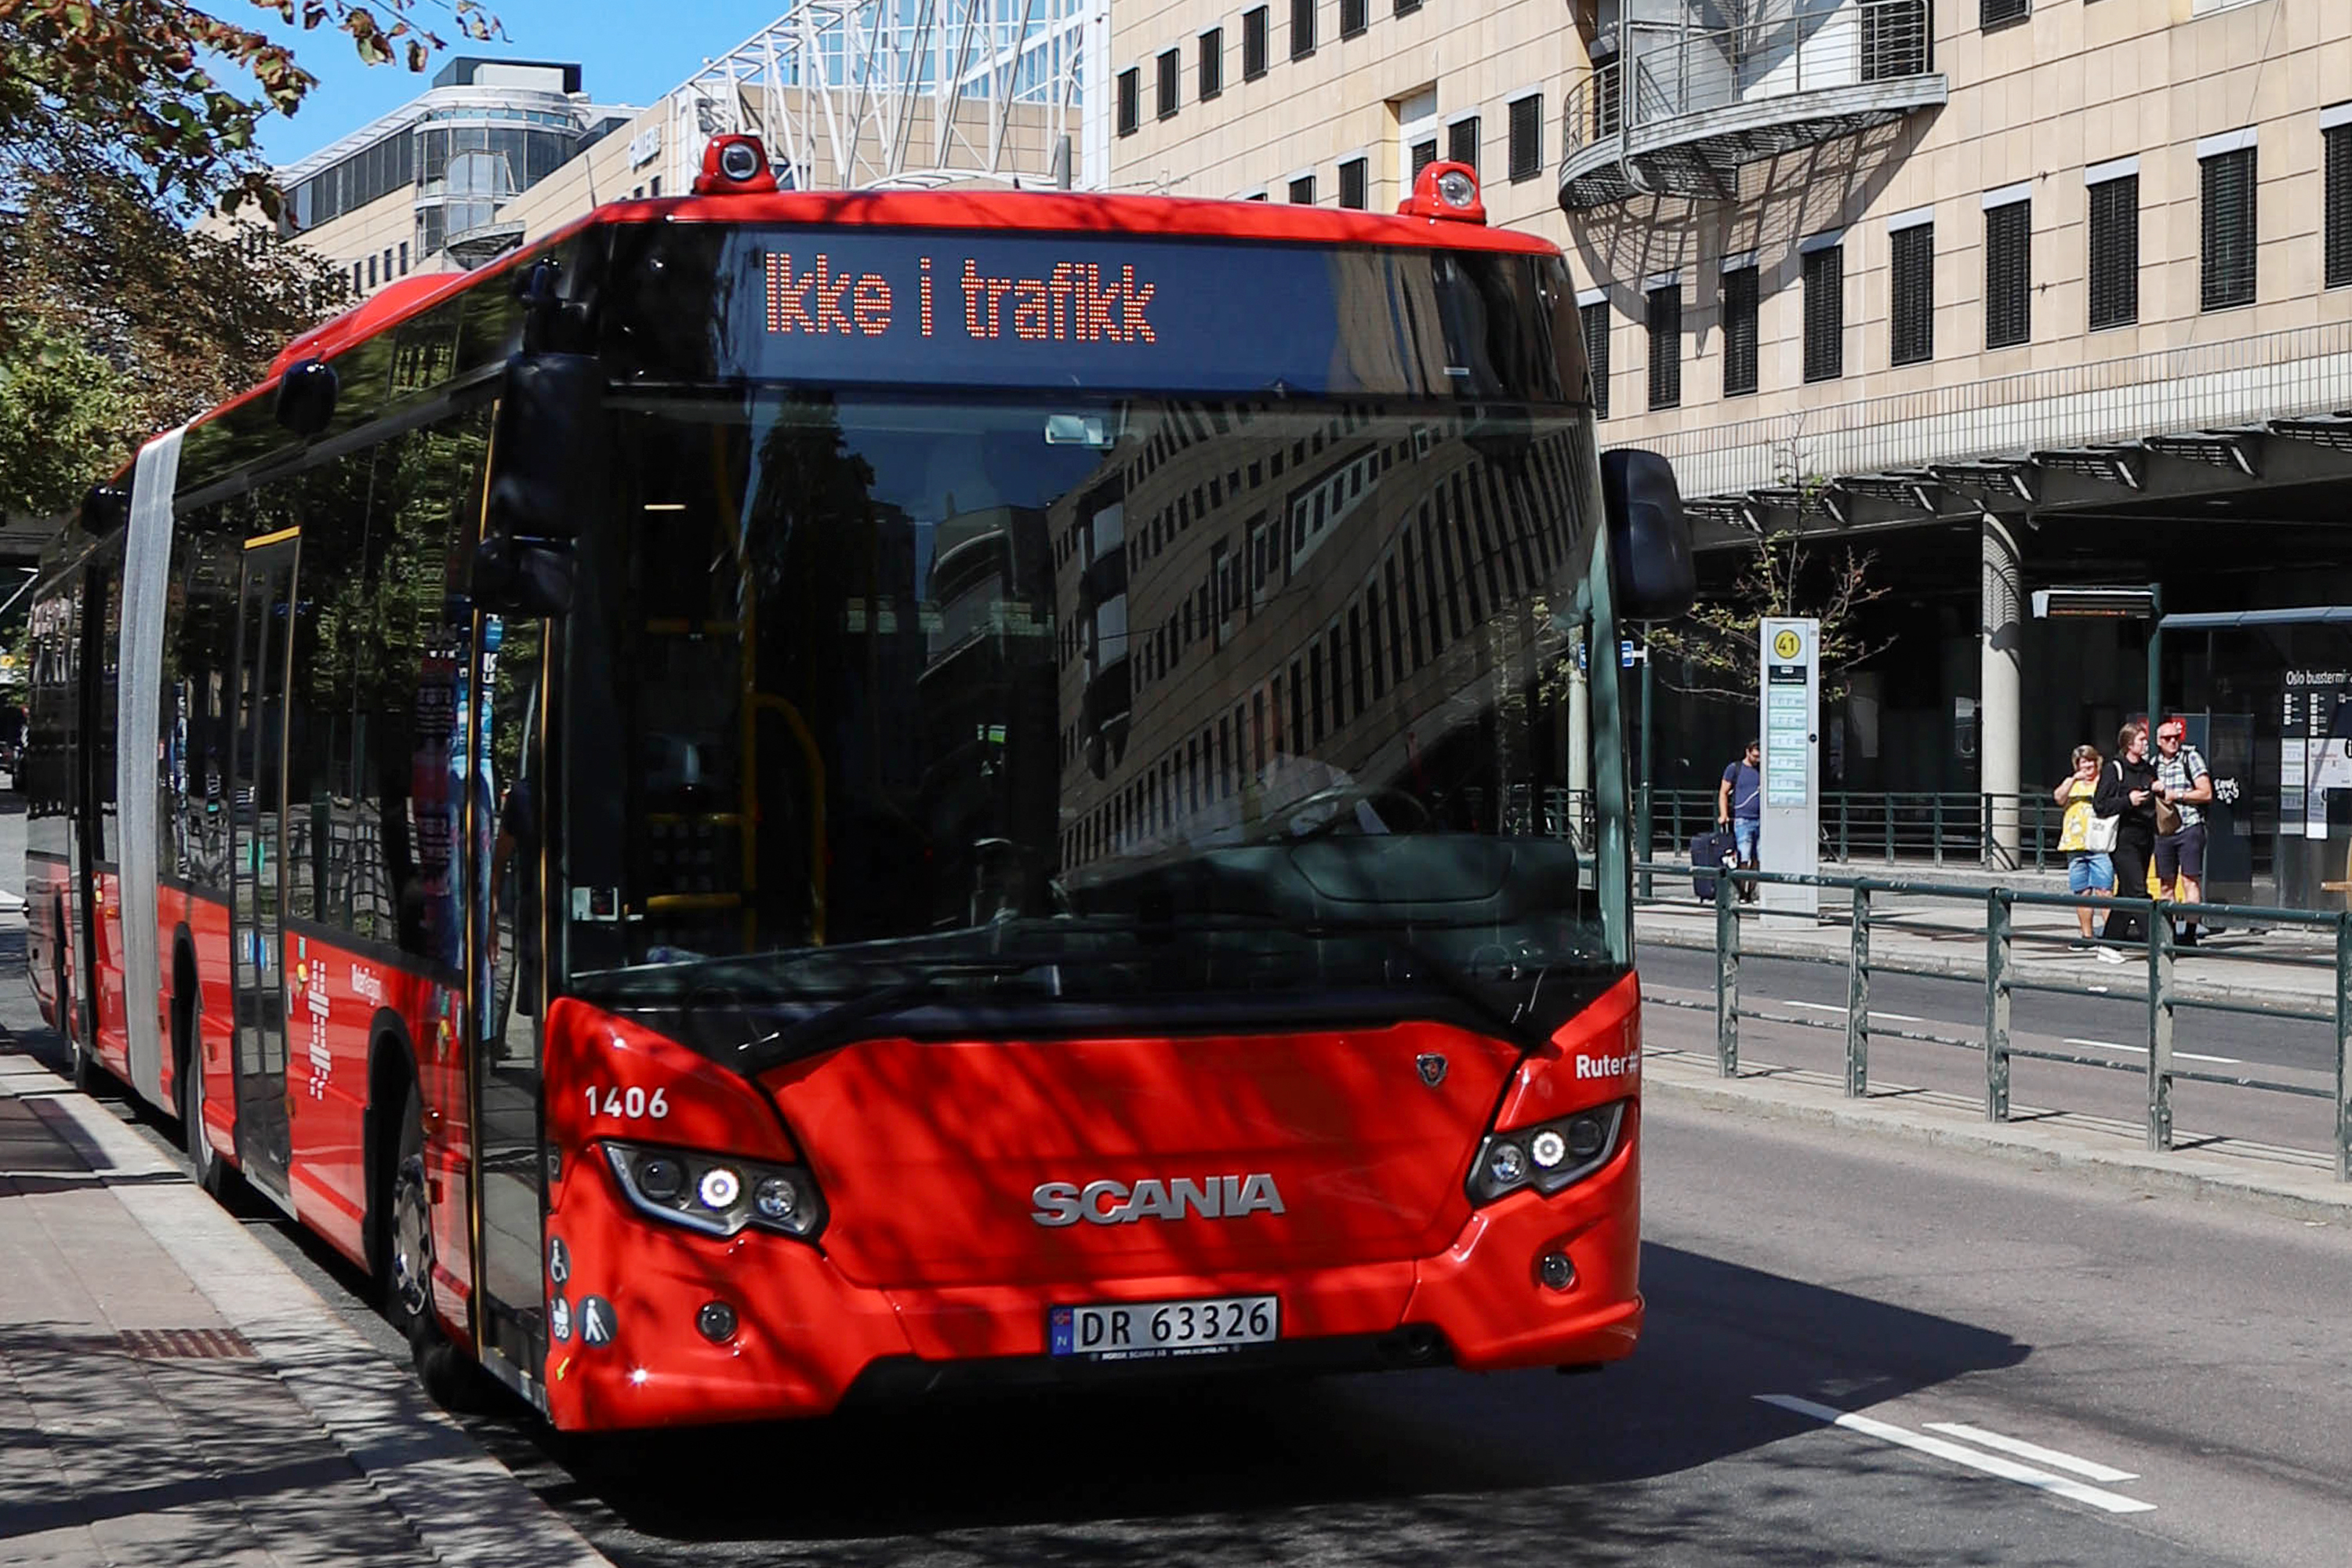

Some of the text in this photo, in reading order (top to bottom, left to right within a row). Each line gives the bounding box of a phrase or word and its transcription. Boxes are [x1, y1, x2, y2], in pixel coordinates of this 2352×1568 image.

[766, 252, 1156, 343] Ikke i trafikk
[1778, 637, 1794, 652] 41
[2285, 670, 2305, 685] Oslo
[585, 1085, 669, 1119] 1406
[1031, 1174, 1286, 1226] SCANIA
[1056, 1335, 1068, 1347] N
[1081, 1301, 1269, 1347] DR 63326
